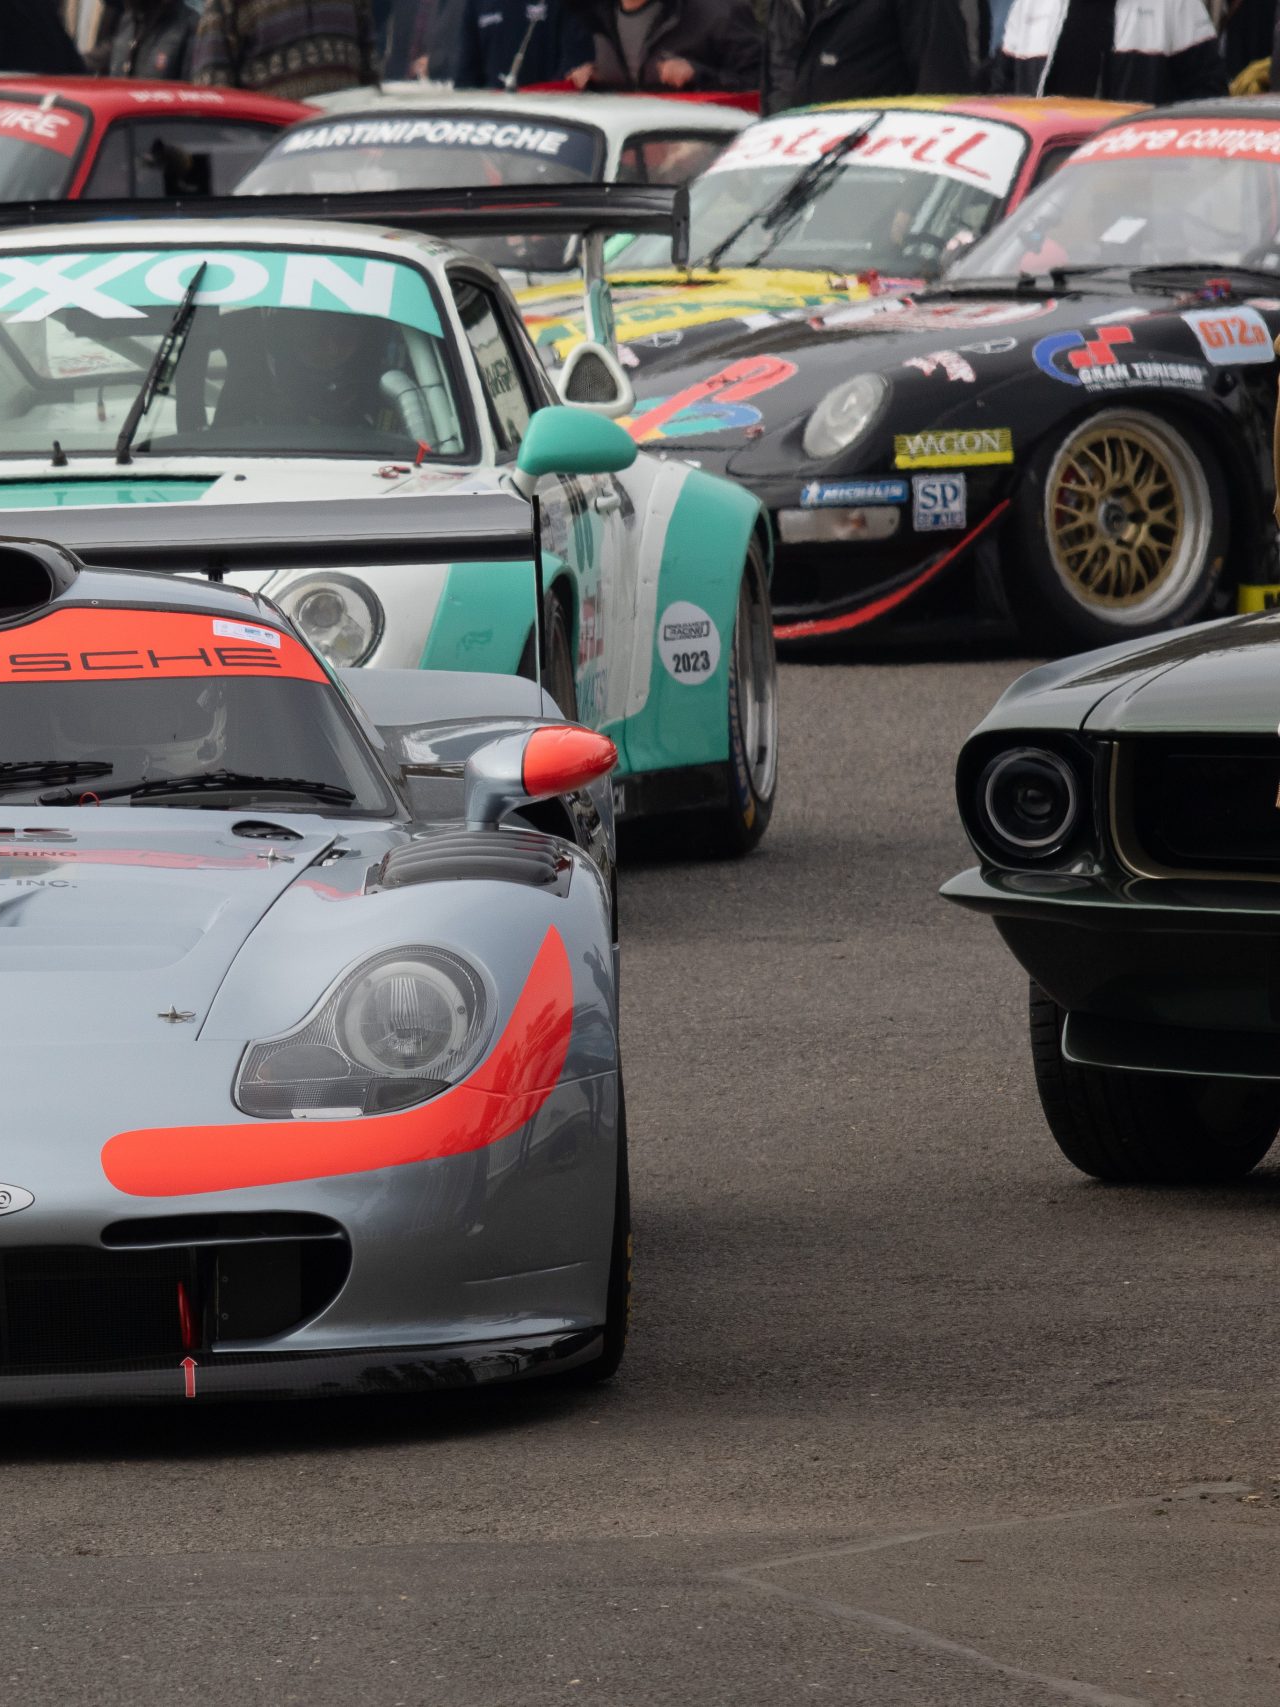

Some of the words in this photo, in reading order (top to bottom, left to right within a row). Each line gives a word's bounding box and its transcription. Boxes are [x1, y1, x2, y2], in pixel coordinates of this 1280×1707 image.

[1078, 363, 1130, 385] GRAN
[1130, 361, 1206, 384] TURISMO
[920, 482, 959, 509] SP
[672, 650, 711, 673] 2023
[16, 879, 79, 889] INC.
